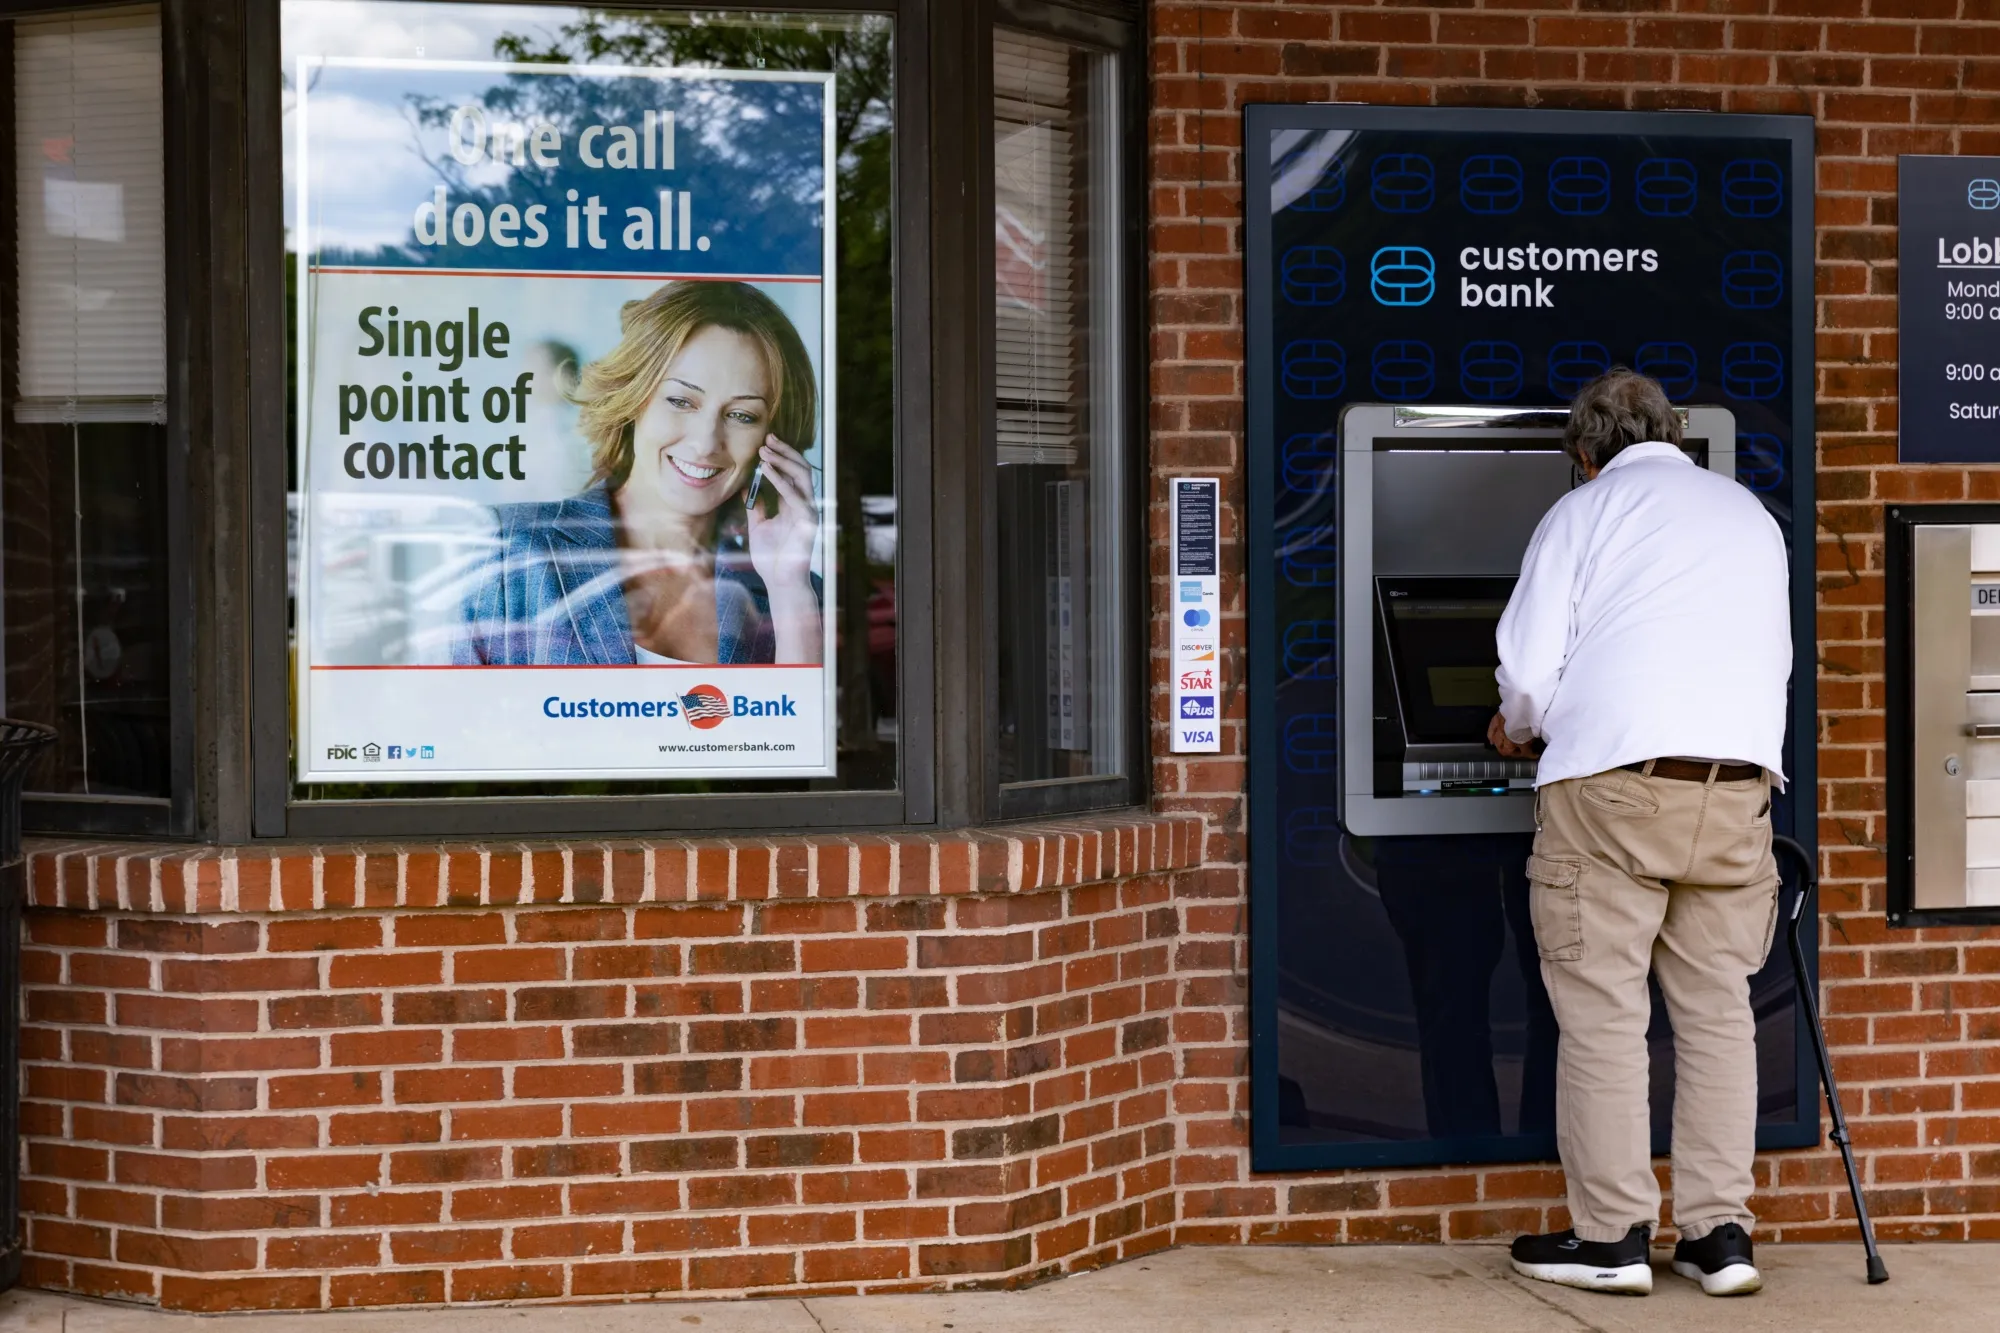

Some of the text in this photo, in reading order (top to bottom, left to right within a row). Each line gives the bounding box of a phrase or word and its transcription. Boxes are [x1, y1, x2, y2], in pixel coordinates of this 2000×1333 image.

[448, 105, 675, 170] One call
[413, 185, 711, 252] does it all.
[1459, 243, 1659, 272] customers
[1460, 277, 1555, 308] bank
[1945, 302, 1984, 320] 9:00
[358, 306, 511, 372] Single
[1945, 363, 1985, 381] 9:00
[339, 372, 534, 435] point of
[343, 435, 527, 480] contact
[1180, 677, 1213, 690] STAR
[543, 694, 797, 719] Customers Bank
[1191, 706, 1213, 716] PLUS
[658, 742, 796, 753] www.customersbank.com
[1182, 731, 1214, 743] VISA
[328, 748, 357, 759] FDIC
